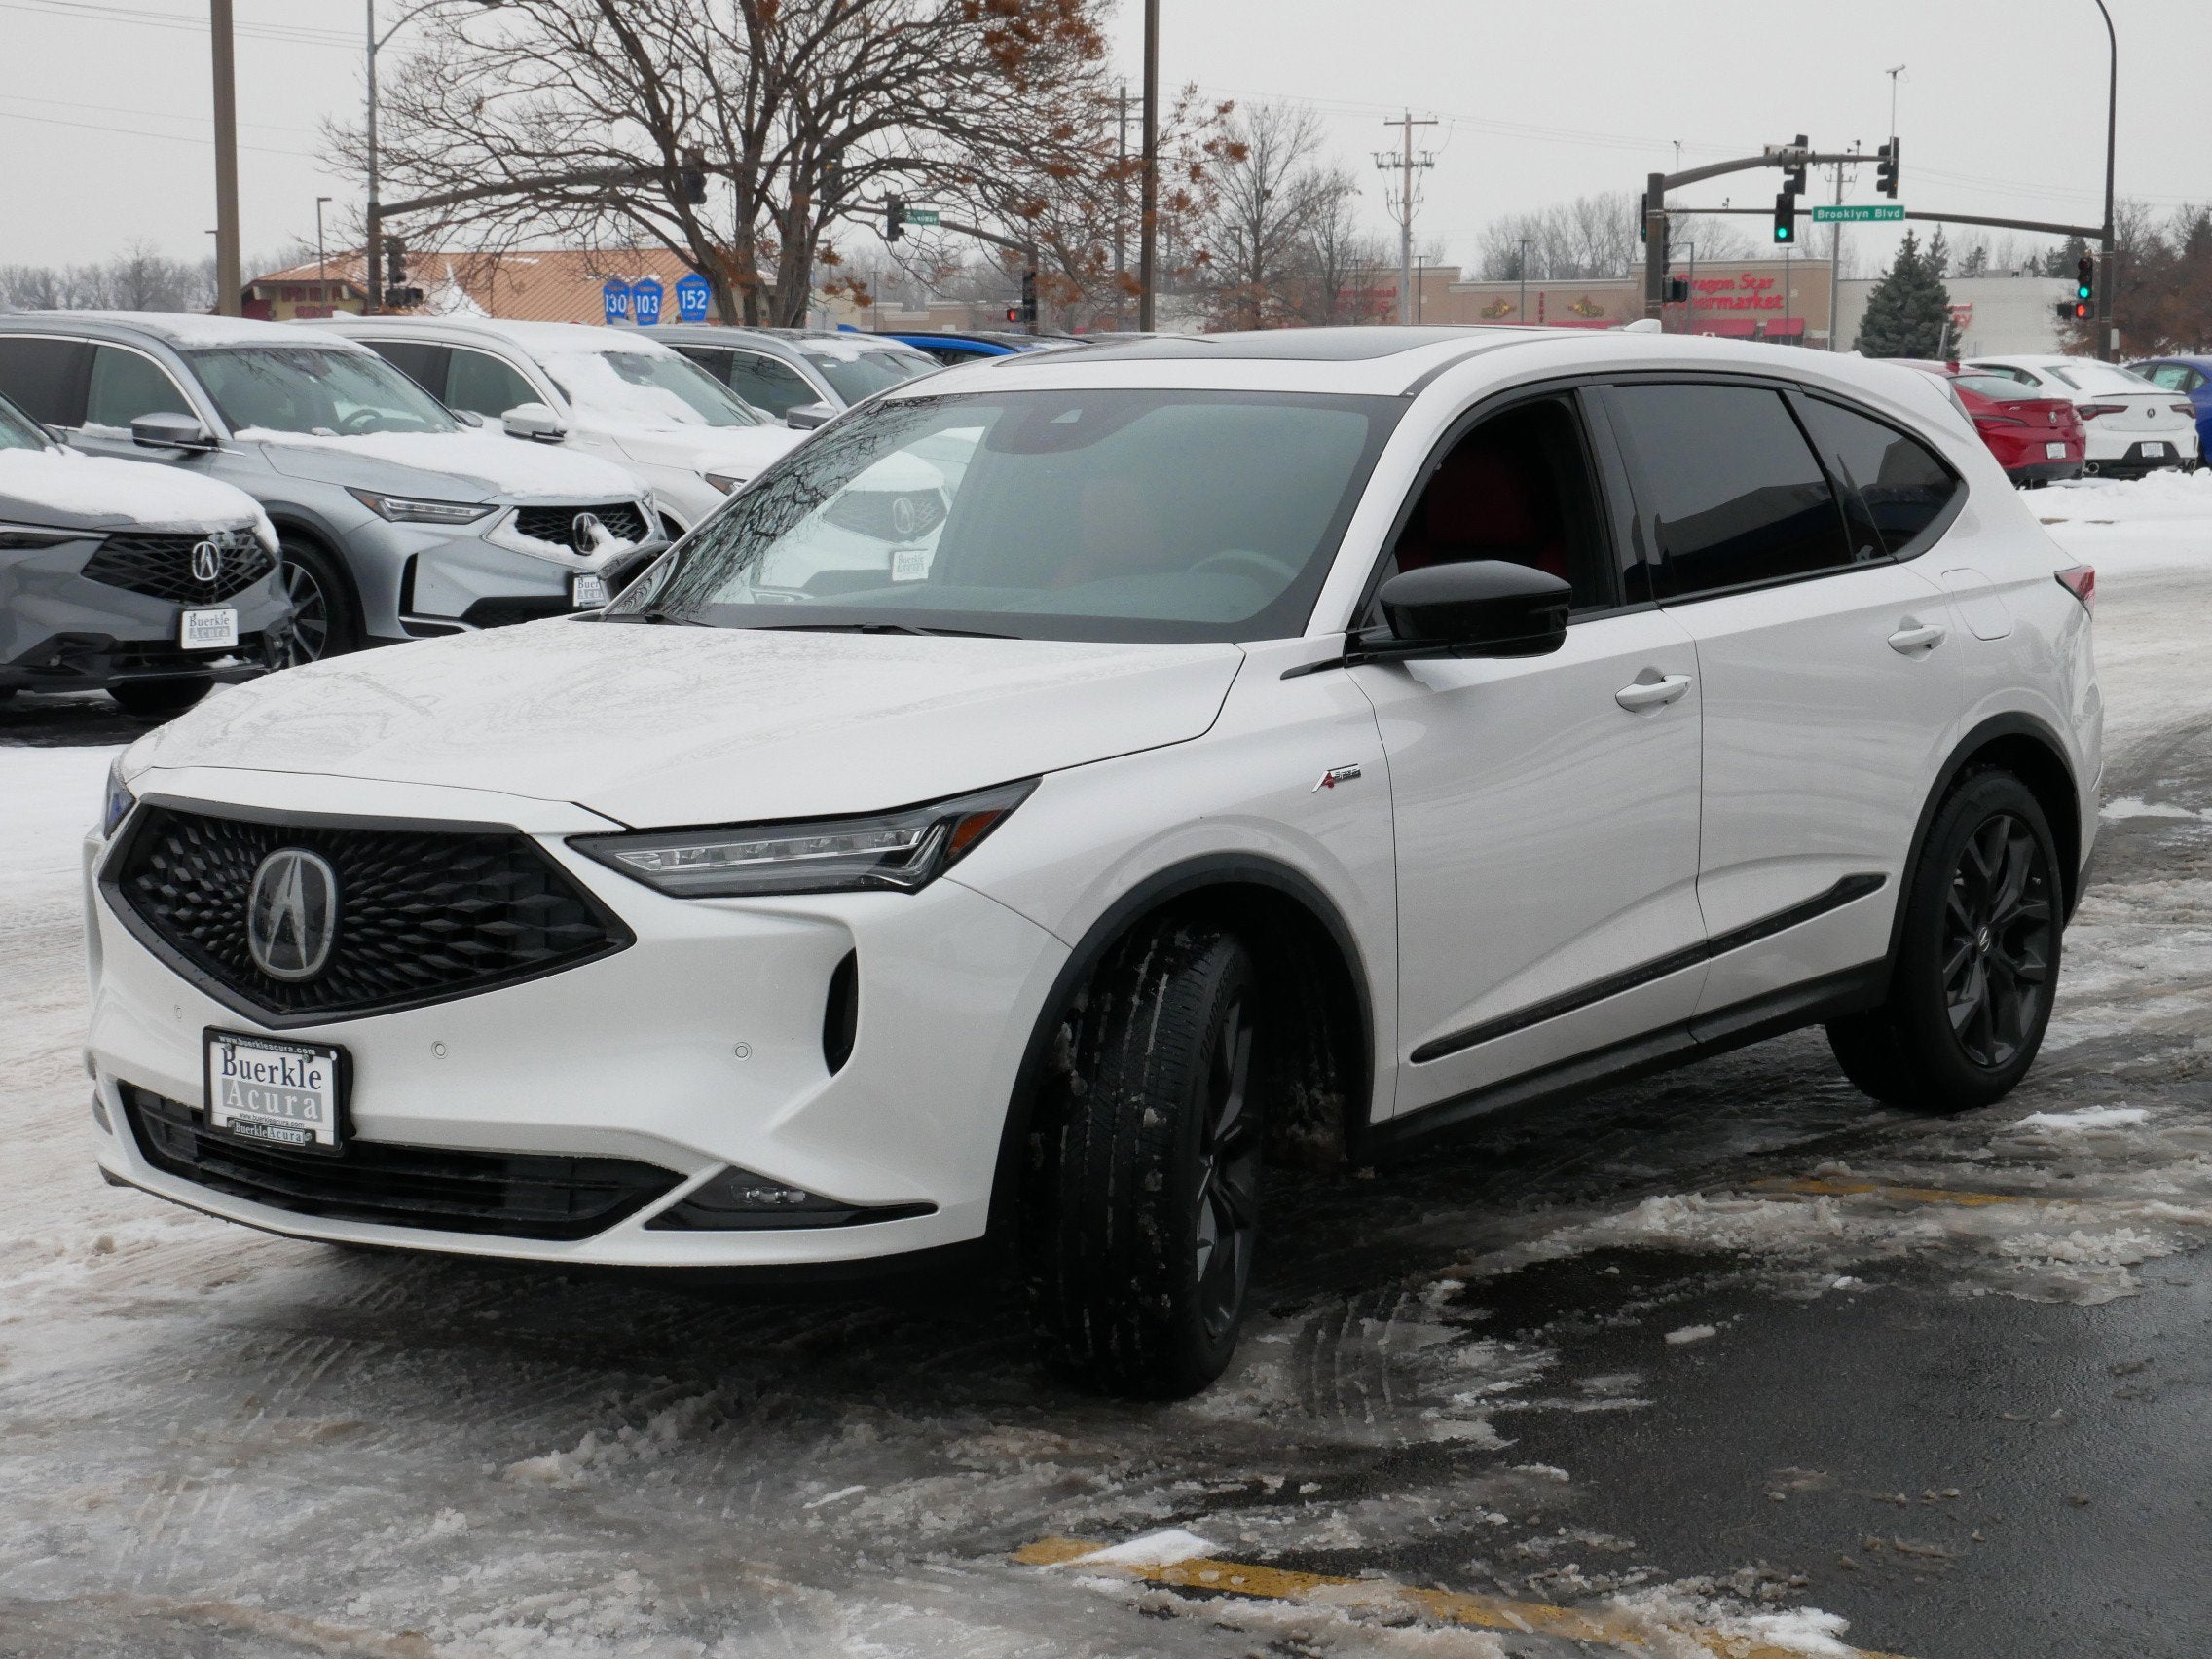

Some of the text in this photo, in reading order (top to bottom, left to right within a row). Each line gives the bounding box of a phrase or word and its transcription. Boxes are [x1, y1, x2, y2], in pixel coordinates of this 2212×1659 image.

[1817, 208, 1900, 220] Brooklyn Blvd
[1739, 273, 1774, 290] Star
[605, 294, 627, 313] 130
[637, 295, 658, 313] 103
[682, 290, 706, 310] 152
[188, 614, 230, 627] Buerkle
[218, 1035, 316, 1056] www.buerkleacura.com
[221, 1047, 322, 1090] Buerkle
[226, 1079, 318, 1119] Acura
[240, 1112, 305, 1128] www.buerkleacura.com
